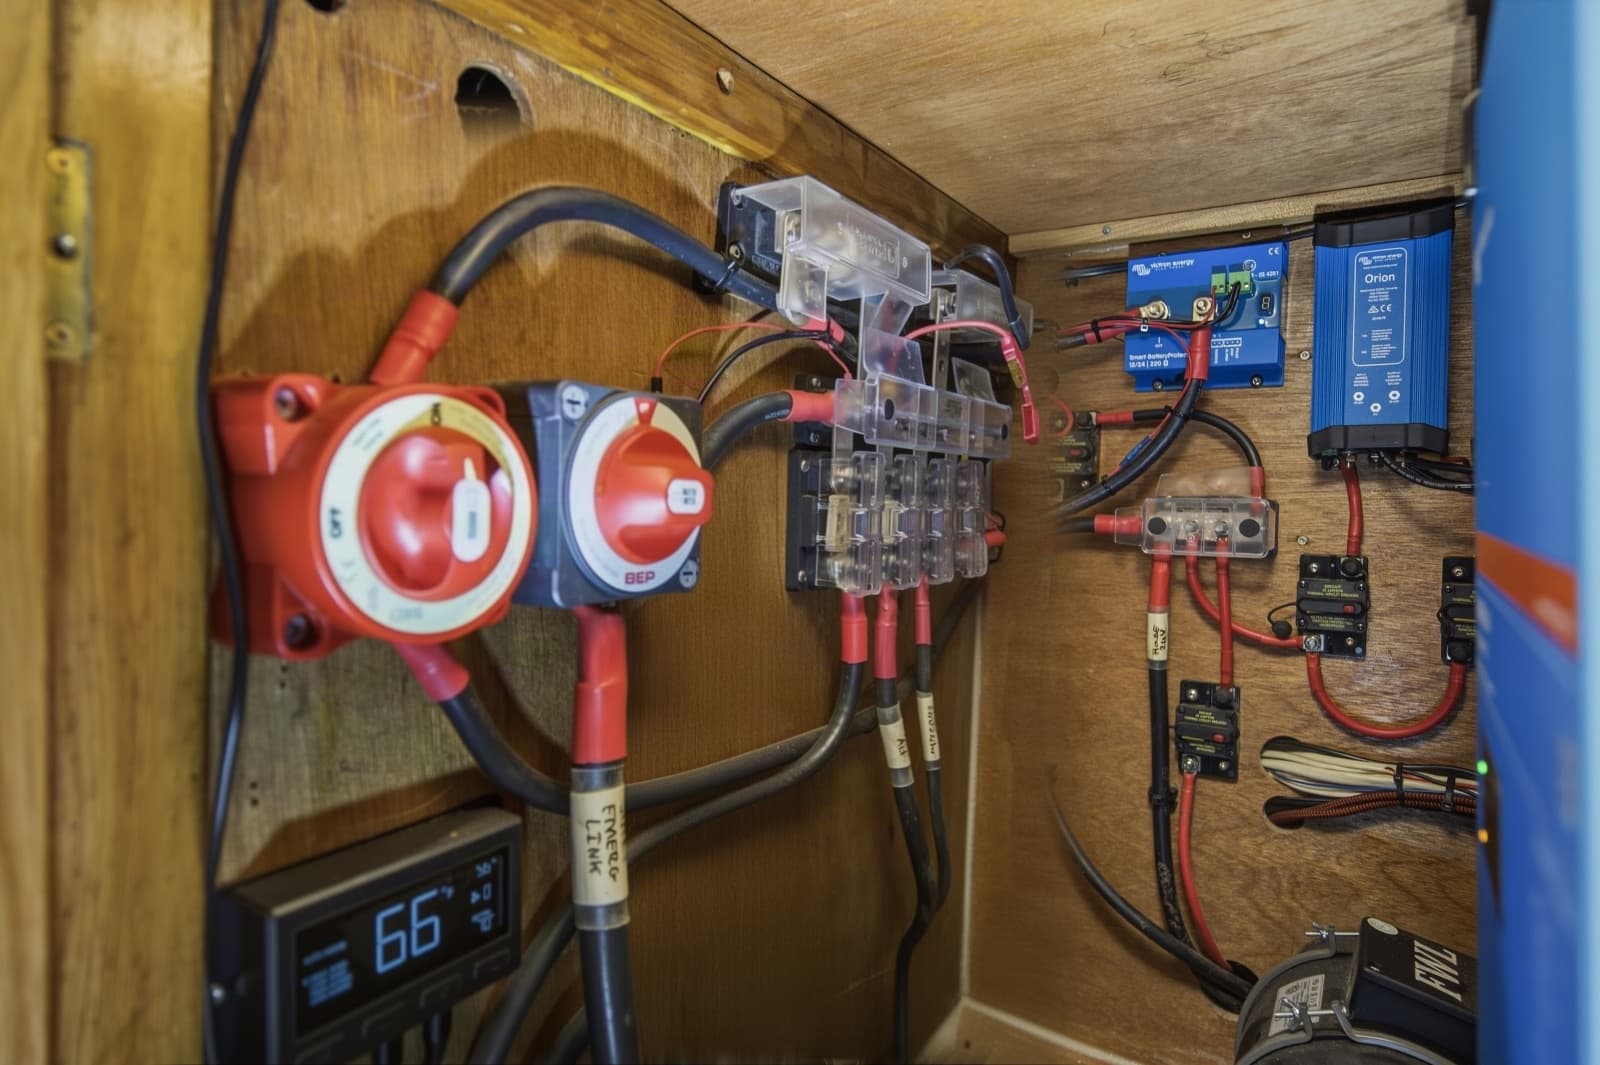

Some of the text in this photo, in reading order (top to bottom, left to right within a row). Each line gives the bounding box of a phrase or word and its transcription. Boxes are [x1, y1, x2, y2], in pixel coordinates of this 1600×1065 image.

[1364, 273, 1395, 284] Orion
[1380, 303, 1392, 312] CE
[624, 571, 655, 585] BEP
[585, 819, 603, 877] LINK
[376, 888, 441, 975] 66
[1413, 939, 1463, 1002] FWL
